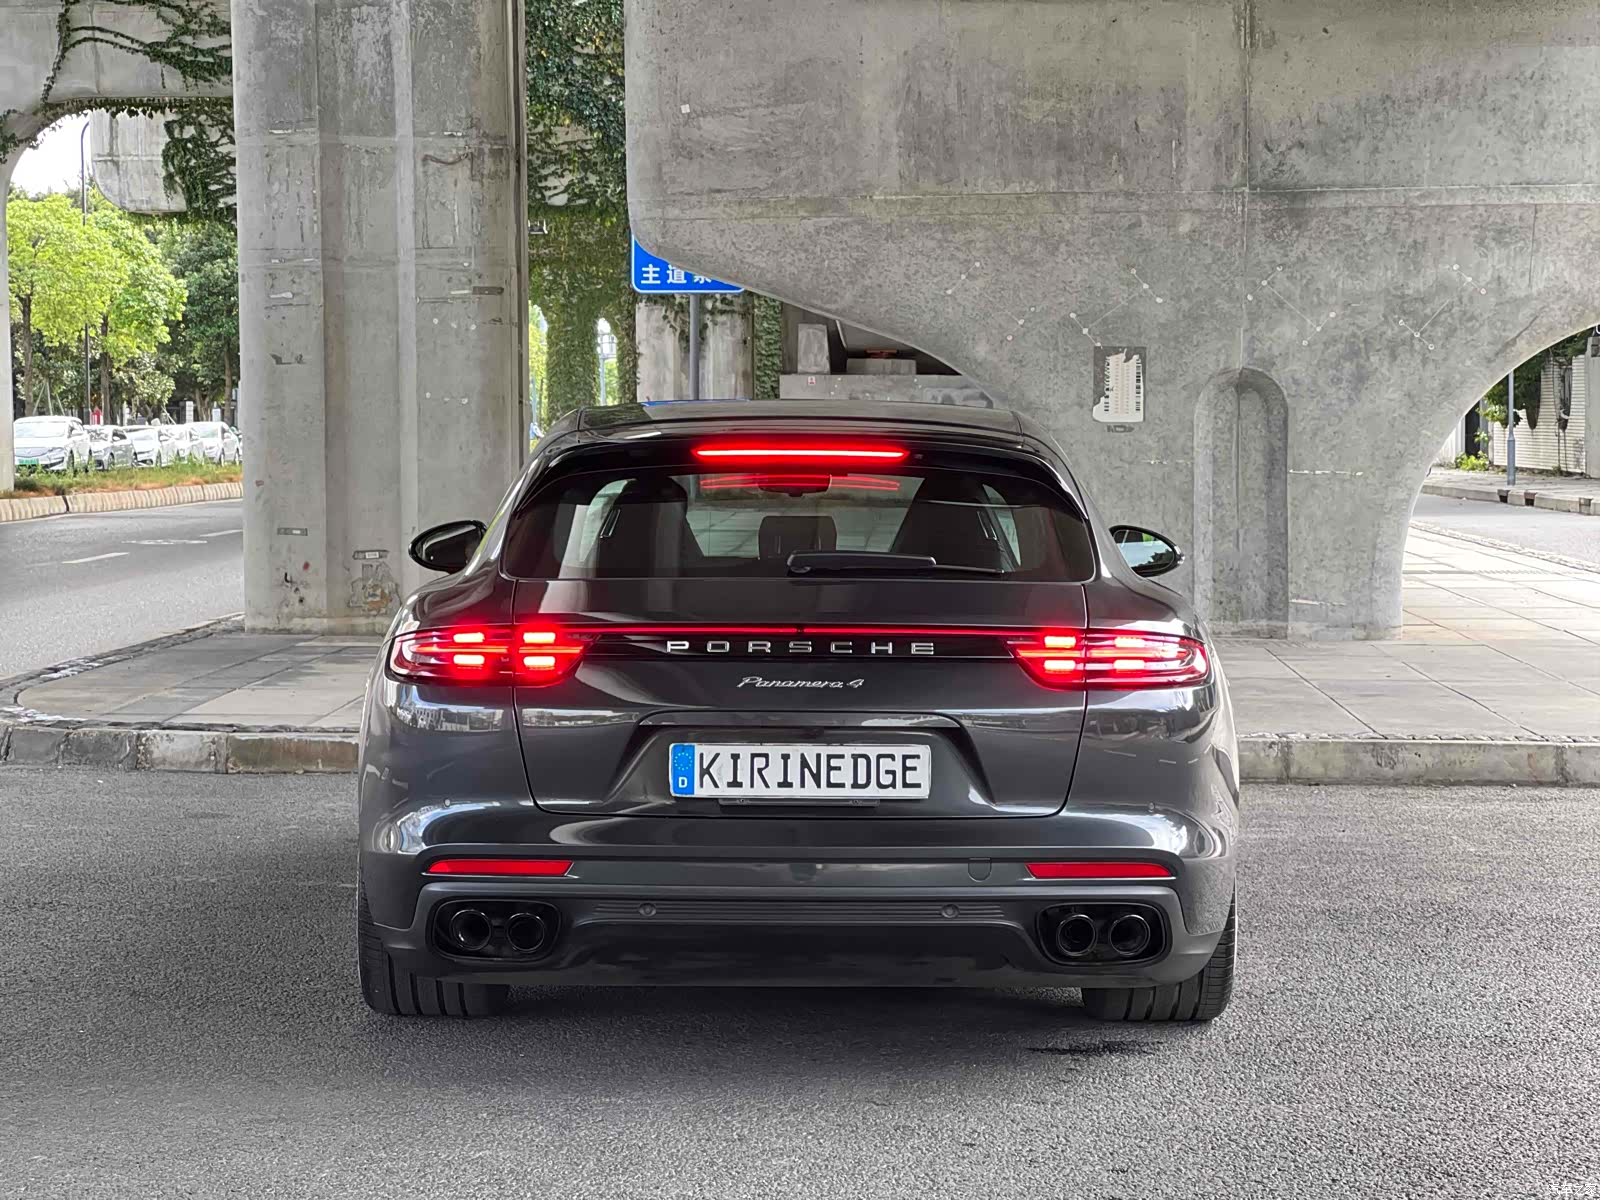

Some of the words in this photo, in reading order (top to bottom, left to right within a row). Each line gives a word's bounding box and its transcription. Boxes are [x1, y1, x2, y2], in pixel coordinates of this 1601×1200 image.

[666, 640, 934, 655] PORSCHE
[736, 676, 843, 688] Panamera
[847, 678, 865, 688] 4
[699, 752, 923, 789] KIRINEDGE
[678, 776, 688, 788] D
